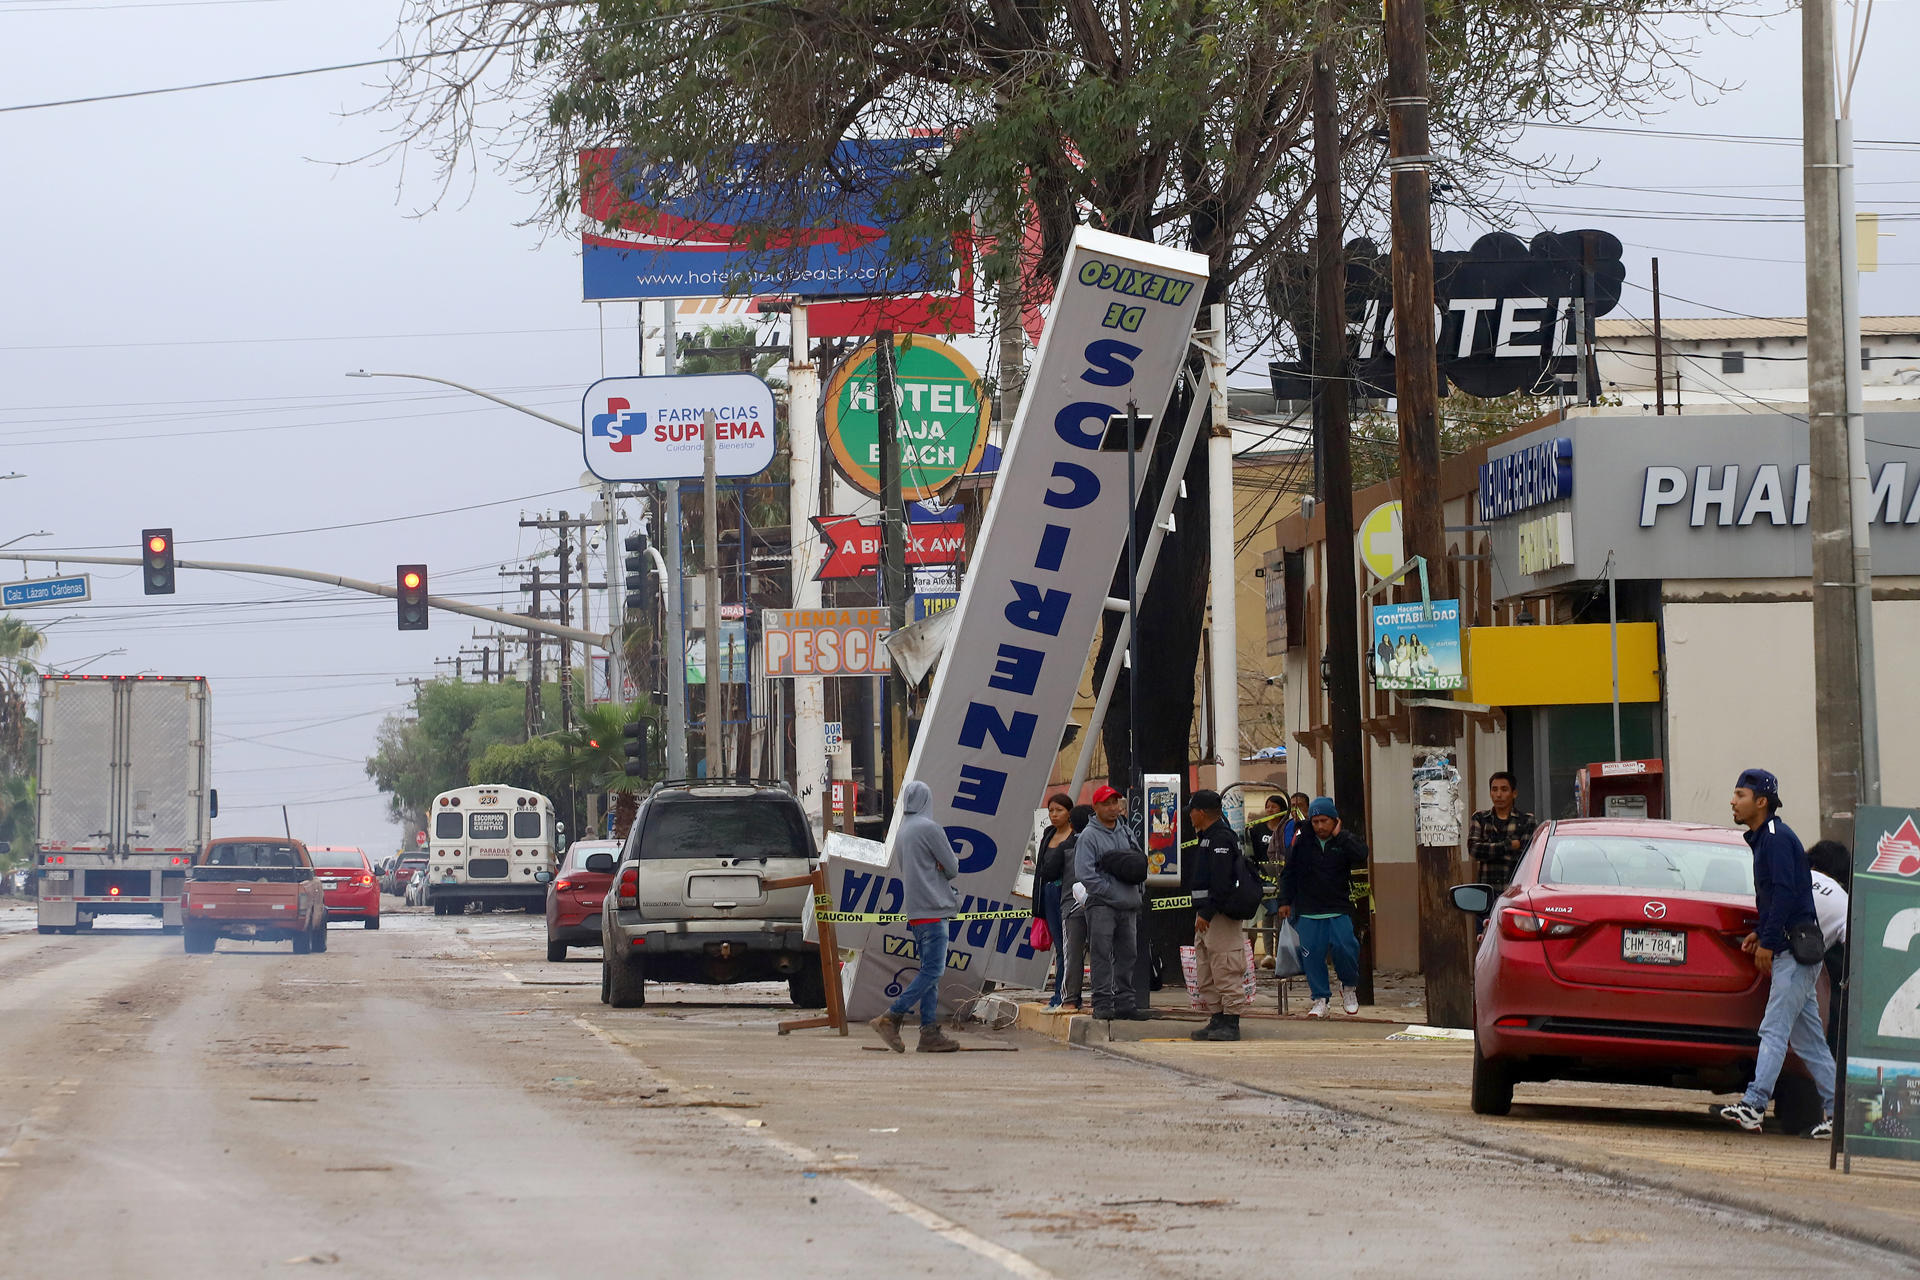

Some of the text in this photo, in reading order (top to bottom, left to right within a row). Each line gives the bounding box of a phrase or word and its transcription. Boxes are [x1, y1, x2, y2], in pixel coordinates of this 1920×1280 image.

[1079, 260, 1195, 306] MEXICO
[1101, 302, 1146, 333] DE
[658, 405, 759, 422] FARMACIAS
[893, 420, 946, 440] AJA
[869, 443, 955, 466] BACH
[841, 539, 857, 554] A
[6, 583, 83, 601] Calz. Lázaro Cárdenas
[942, 338, 1145, 875] GENERICOS
[1397, 605, 1424, 613] Hacemo
[782, 609, 881, 627] TIENDA DE
[1376, 609, 1457, 626] CONTABIDAD
[765, 626, 891, 675] PESCA
[1433, 675, 1462, 689] 1873
[480, 796, 498, 805] 230
